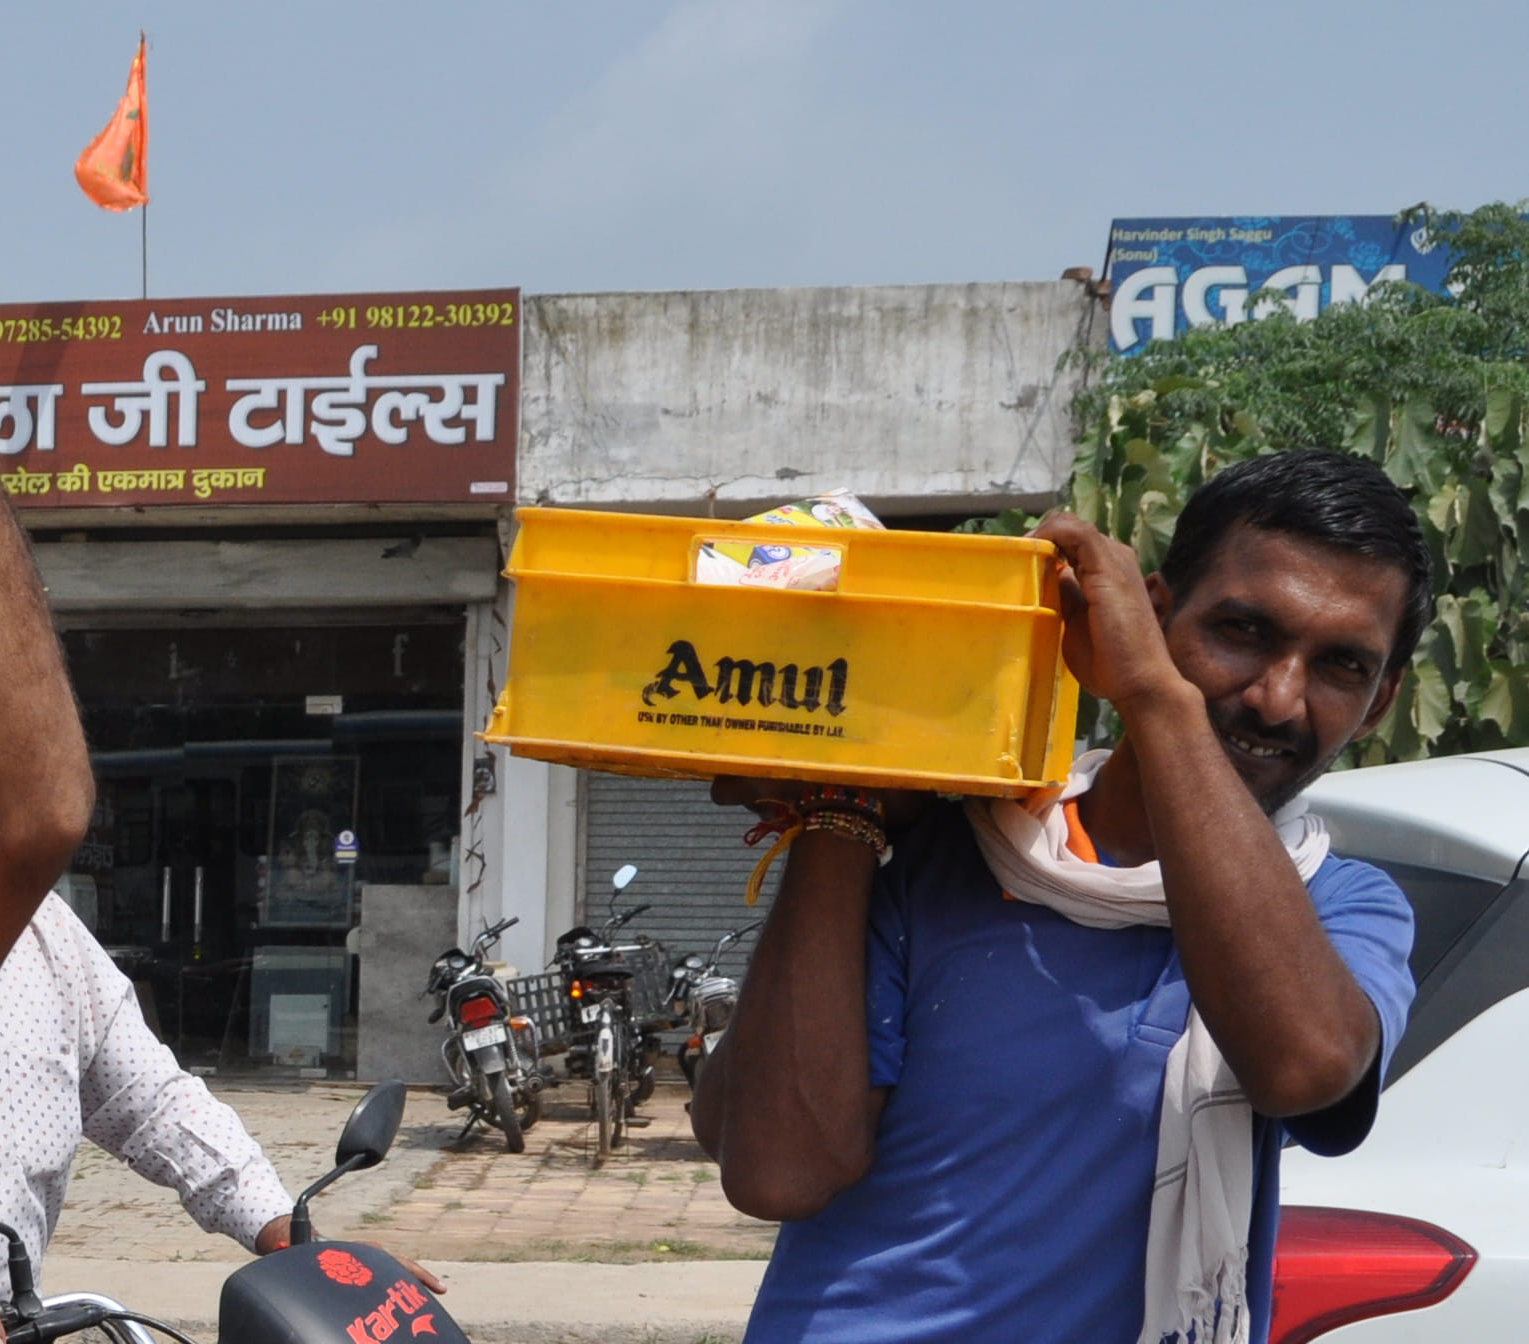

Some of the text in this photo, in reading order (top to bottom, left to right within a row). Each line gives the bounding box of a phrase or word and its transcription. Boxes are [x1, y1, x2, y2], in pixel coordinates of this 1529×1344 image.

[1186, 227, 1226, 244] Singh
[142, 307, 303, 335] Arun Sharma
[316, 303, 514, 330] +91 98122-30392
[81, 350, 206, 448] जी
[226, 344, 506, 456] टाईल्स
[57, 463, 92, 492] की
[97, 468, 186, 492] एकमात्र
[191, 467, 267, 498] दुकान
[641, 639, 848, 717] Amul
[656, 713, 668, 725] BY
[670, 713, 698, 727] OTHER
